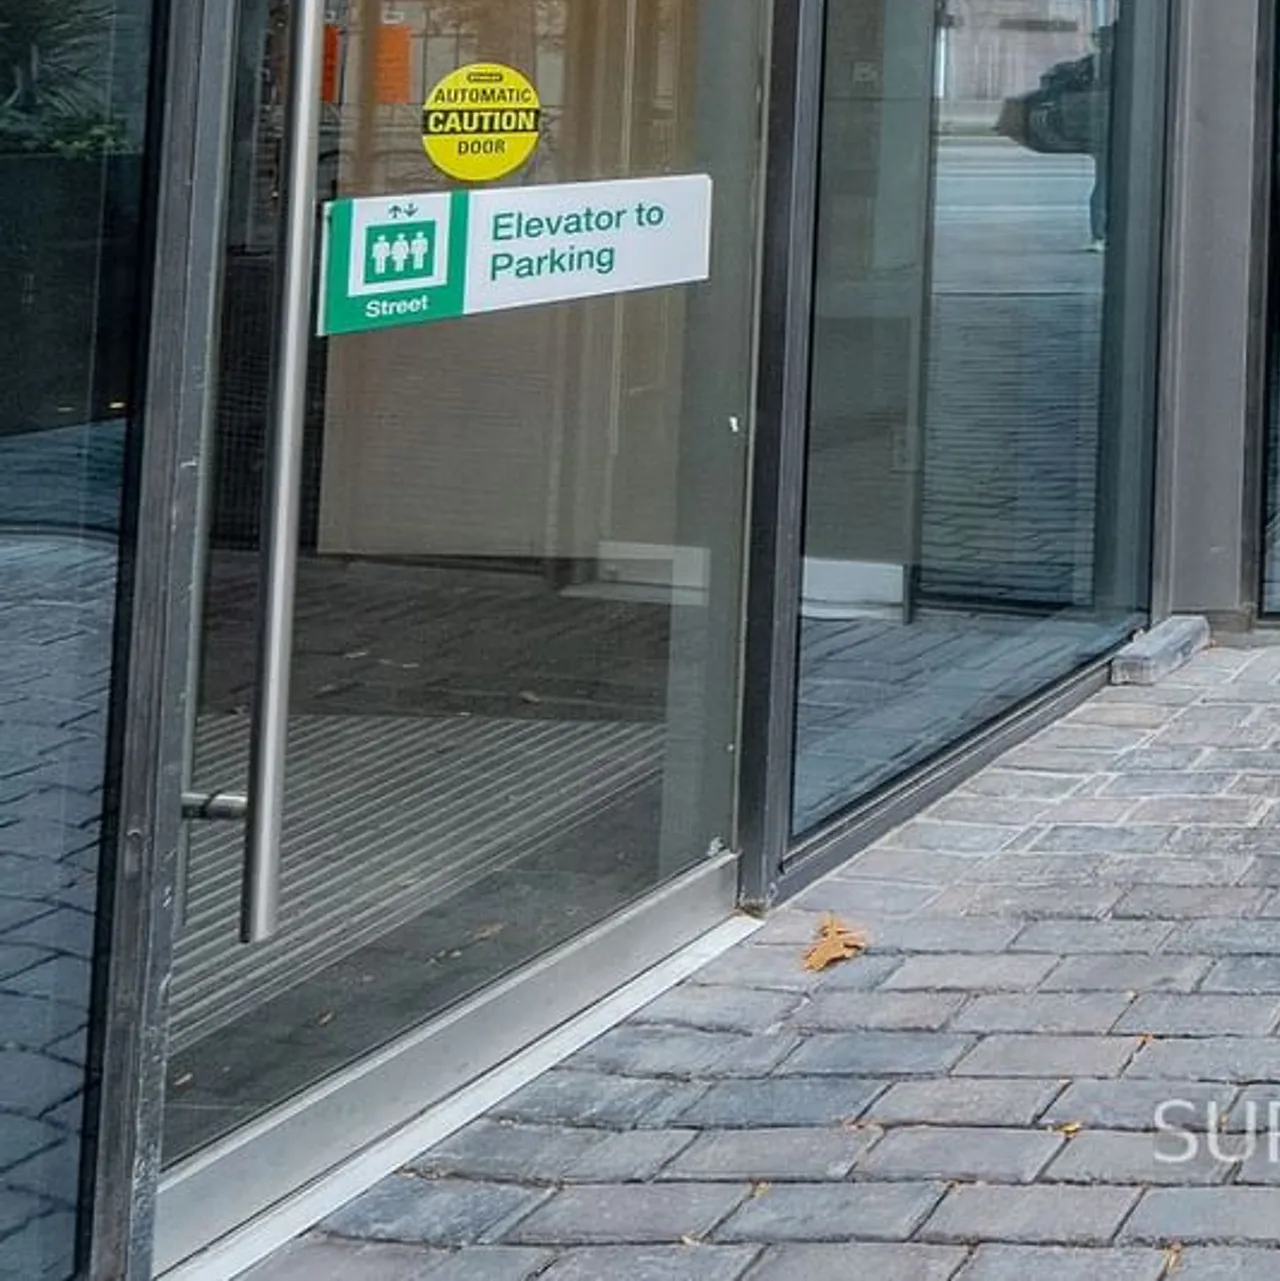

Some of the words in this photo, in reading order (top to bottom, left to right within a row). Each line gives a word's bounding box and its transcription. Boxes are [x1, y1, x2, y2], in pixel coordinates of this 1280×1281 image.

[434, 87, 532, 103] AUTOMATIC
[428, 111, 535, 133] CAUTION
[458, 139, 506, 155] DOOR
[491, 207, 626, 242] Elevator
[635, 202, 664, 227] to
[490, 244, 615, 282] Parking
[364, 294, 429, 318] Street
